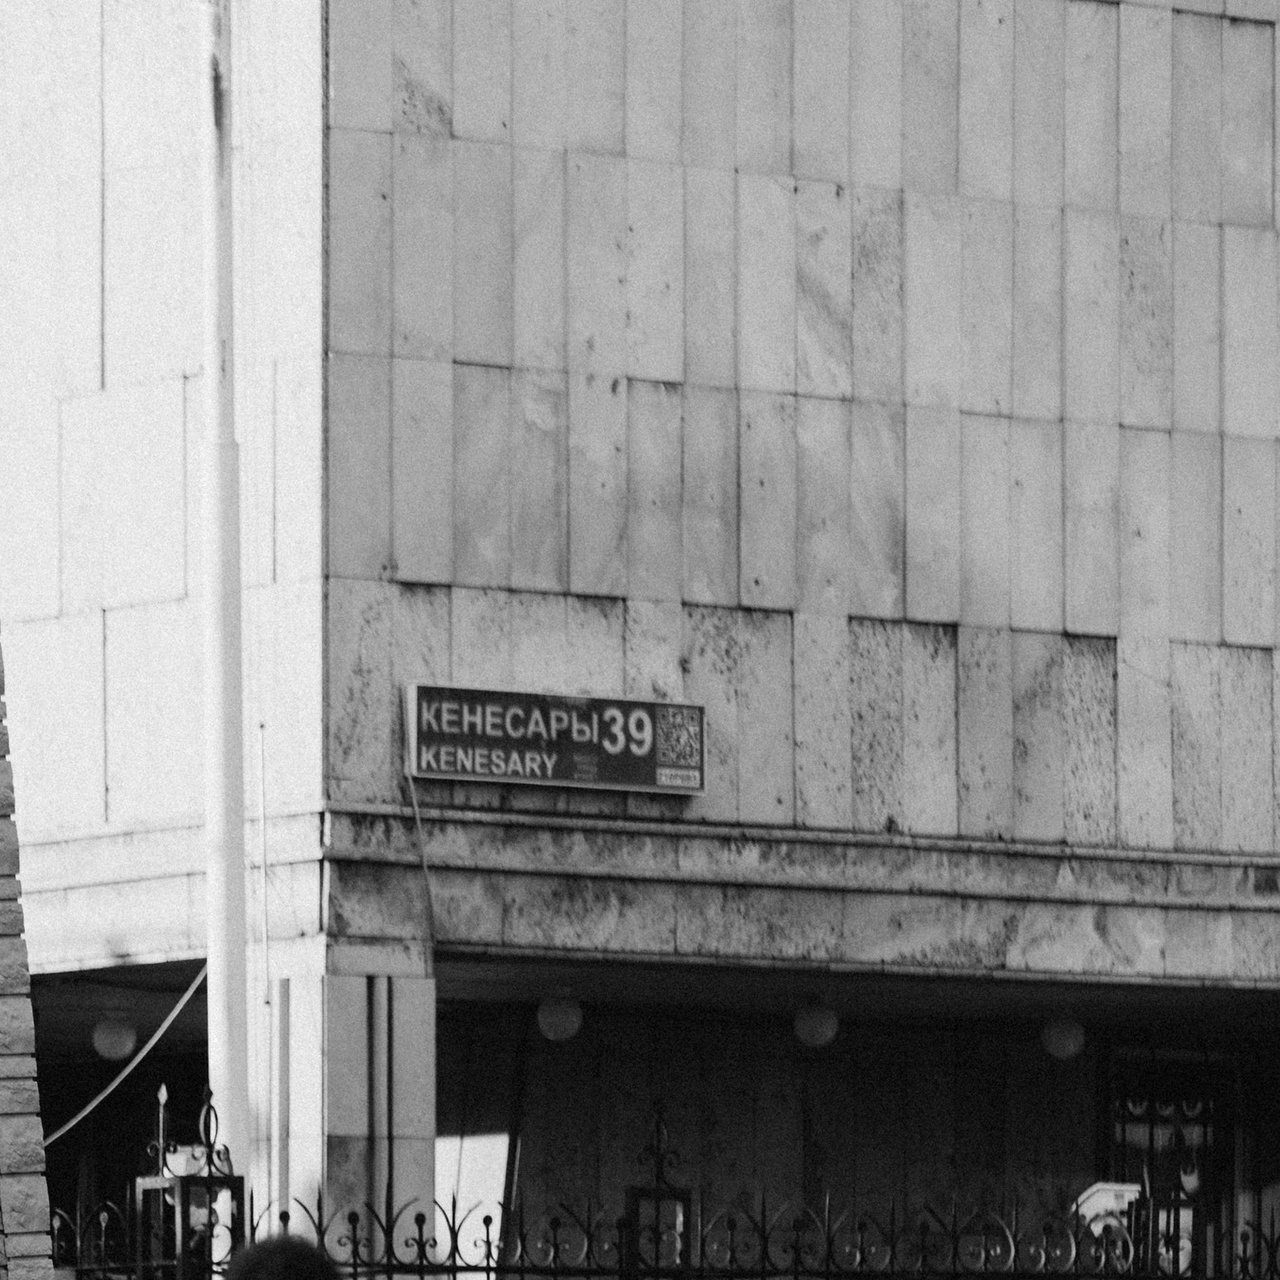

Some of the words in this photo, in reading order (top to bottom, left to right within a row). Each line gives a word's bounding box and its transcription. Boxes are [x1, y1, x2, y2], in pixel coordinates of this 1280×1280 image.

[421, 702, 599, 744] КЕНЕСАРЫ
[602, 707, 653, 756] 39
[421, 746, 558, 778] KENESARY
